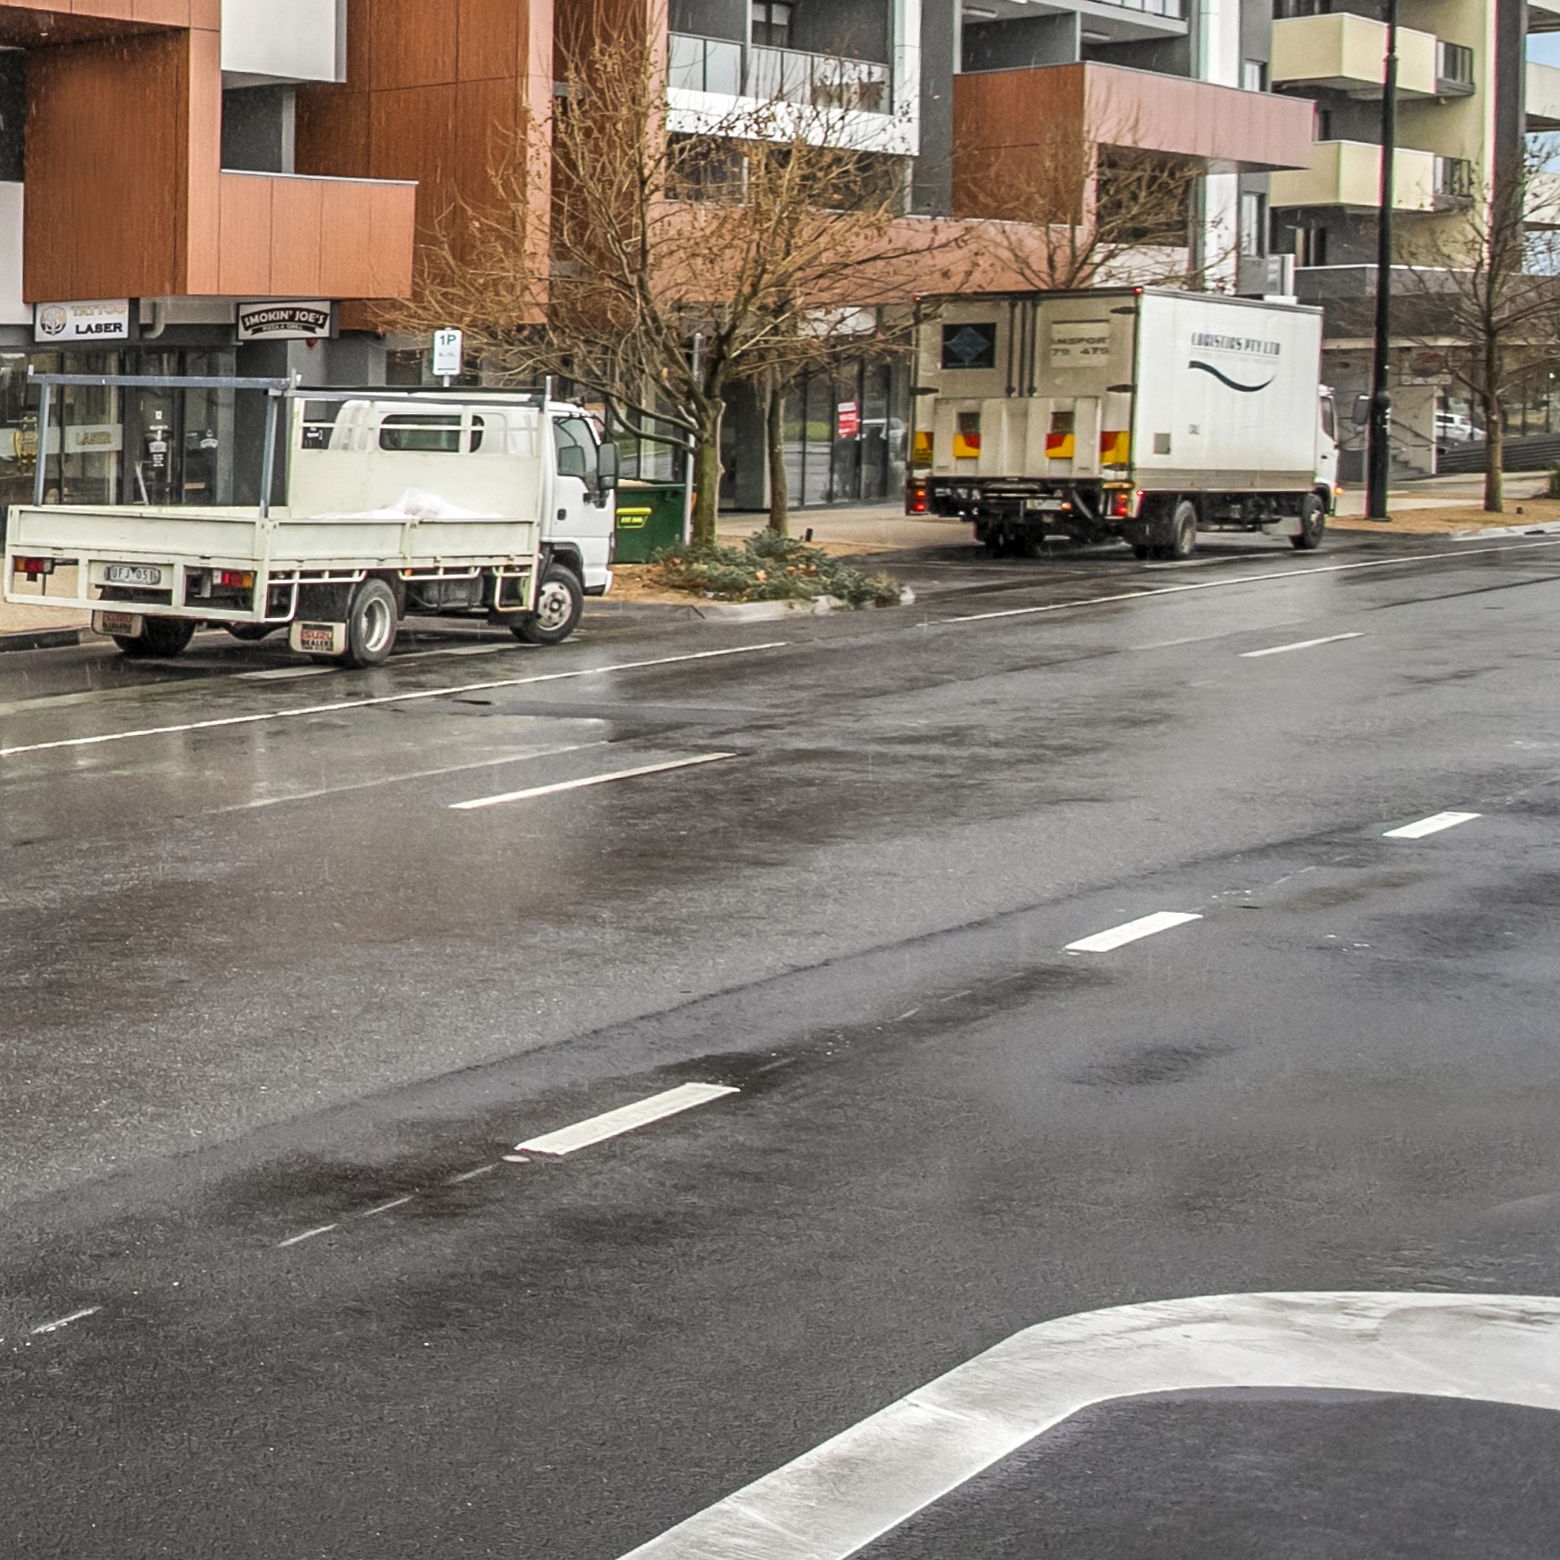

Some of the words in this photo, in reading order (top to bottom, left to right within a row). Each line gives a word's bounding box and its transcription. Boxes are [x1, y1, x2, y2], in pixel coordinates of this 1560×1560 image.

[71, 304, 126, 316] TATTOO
[244, 311, 293, 327] SMOKIN'
[295, 311, 325, 324] JOE'S
[75, 323, 123, 334] LASER
[440, 334, 457, 345] 1P
[1245, 338, 1261, 352] PTY
